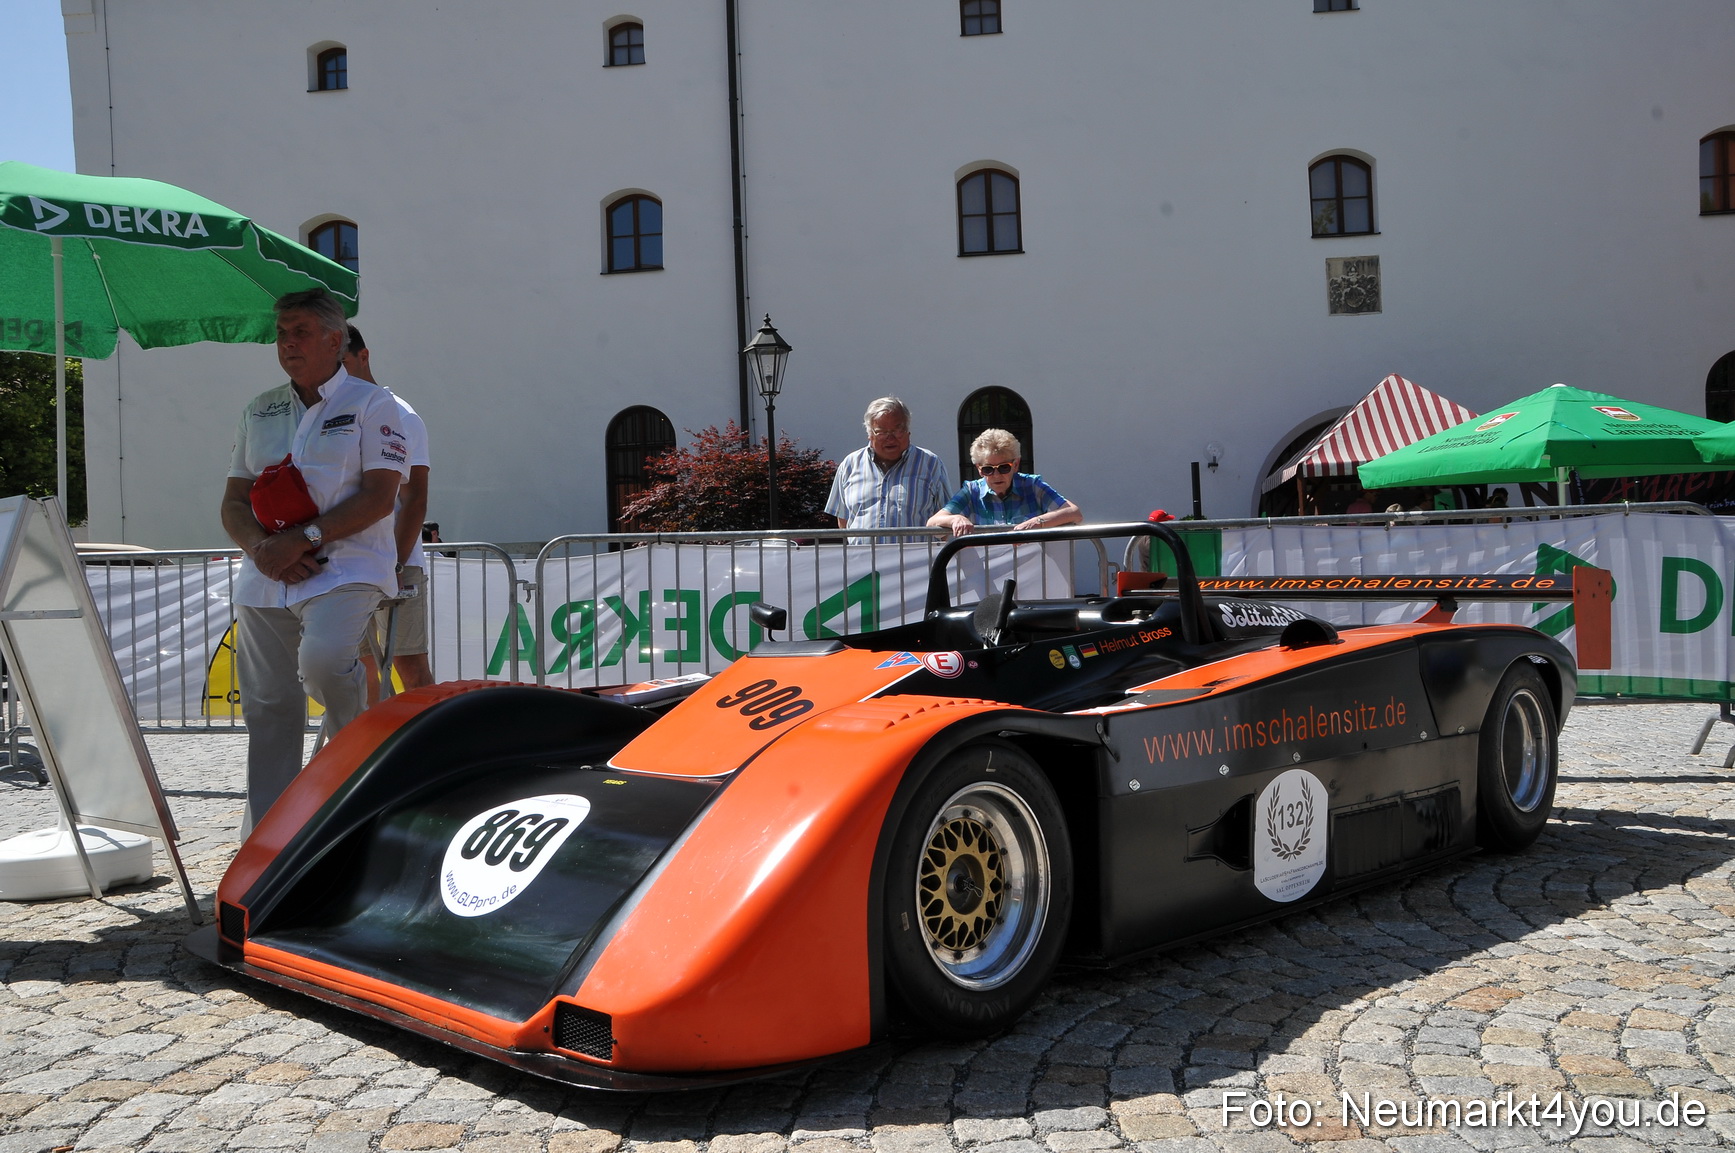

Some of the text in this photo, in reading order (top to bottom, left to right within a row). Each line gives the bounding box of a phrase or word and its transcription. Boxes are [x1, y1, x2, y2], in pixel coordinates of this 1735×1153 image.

[83, 203, 210, 239] DEKRA
[1099, 626, 1173, 654] Helmut Bross
[933, 653, 953, 670] E
[716, 678, 815, 731] 909
[1143, 696, 1407, 764] www.imschalensitz.de
[1277, 801, 1305, 831] 132
[460, 809, 570, 873] 869
[445, 869, 517, 911] www.GLPpro.de
